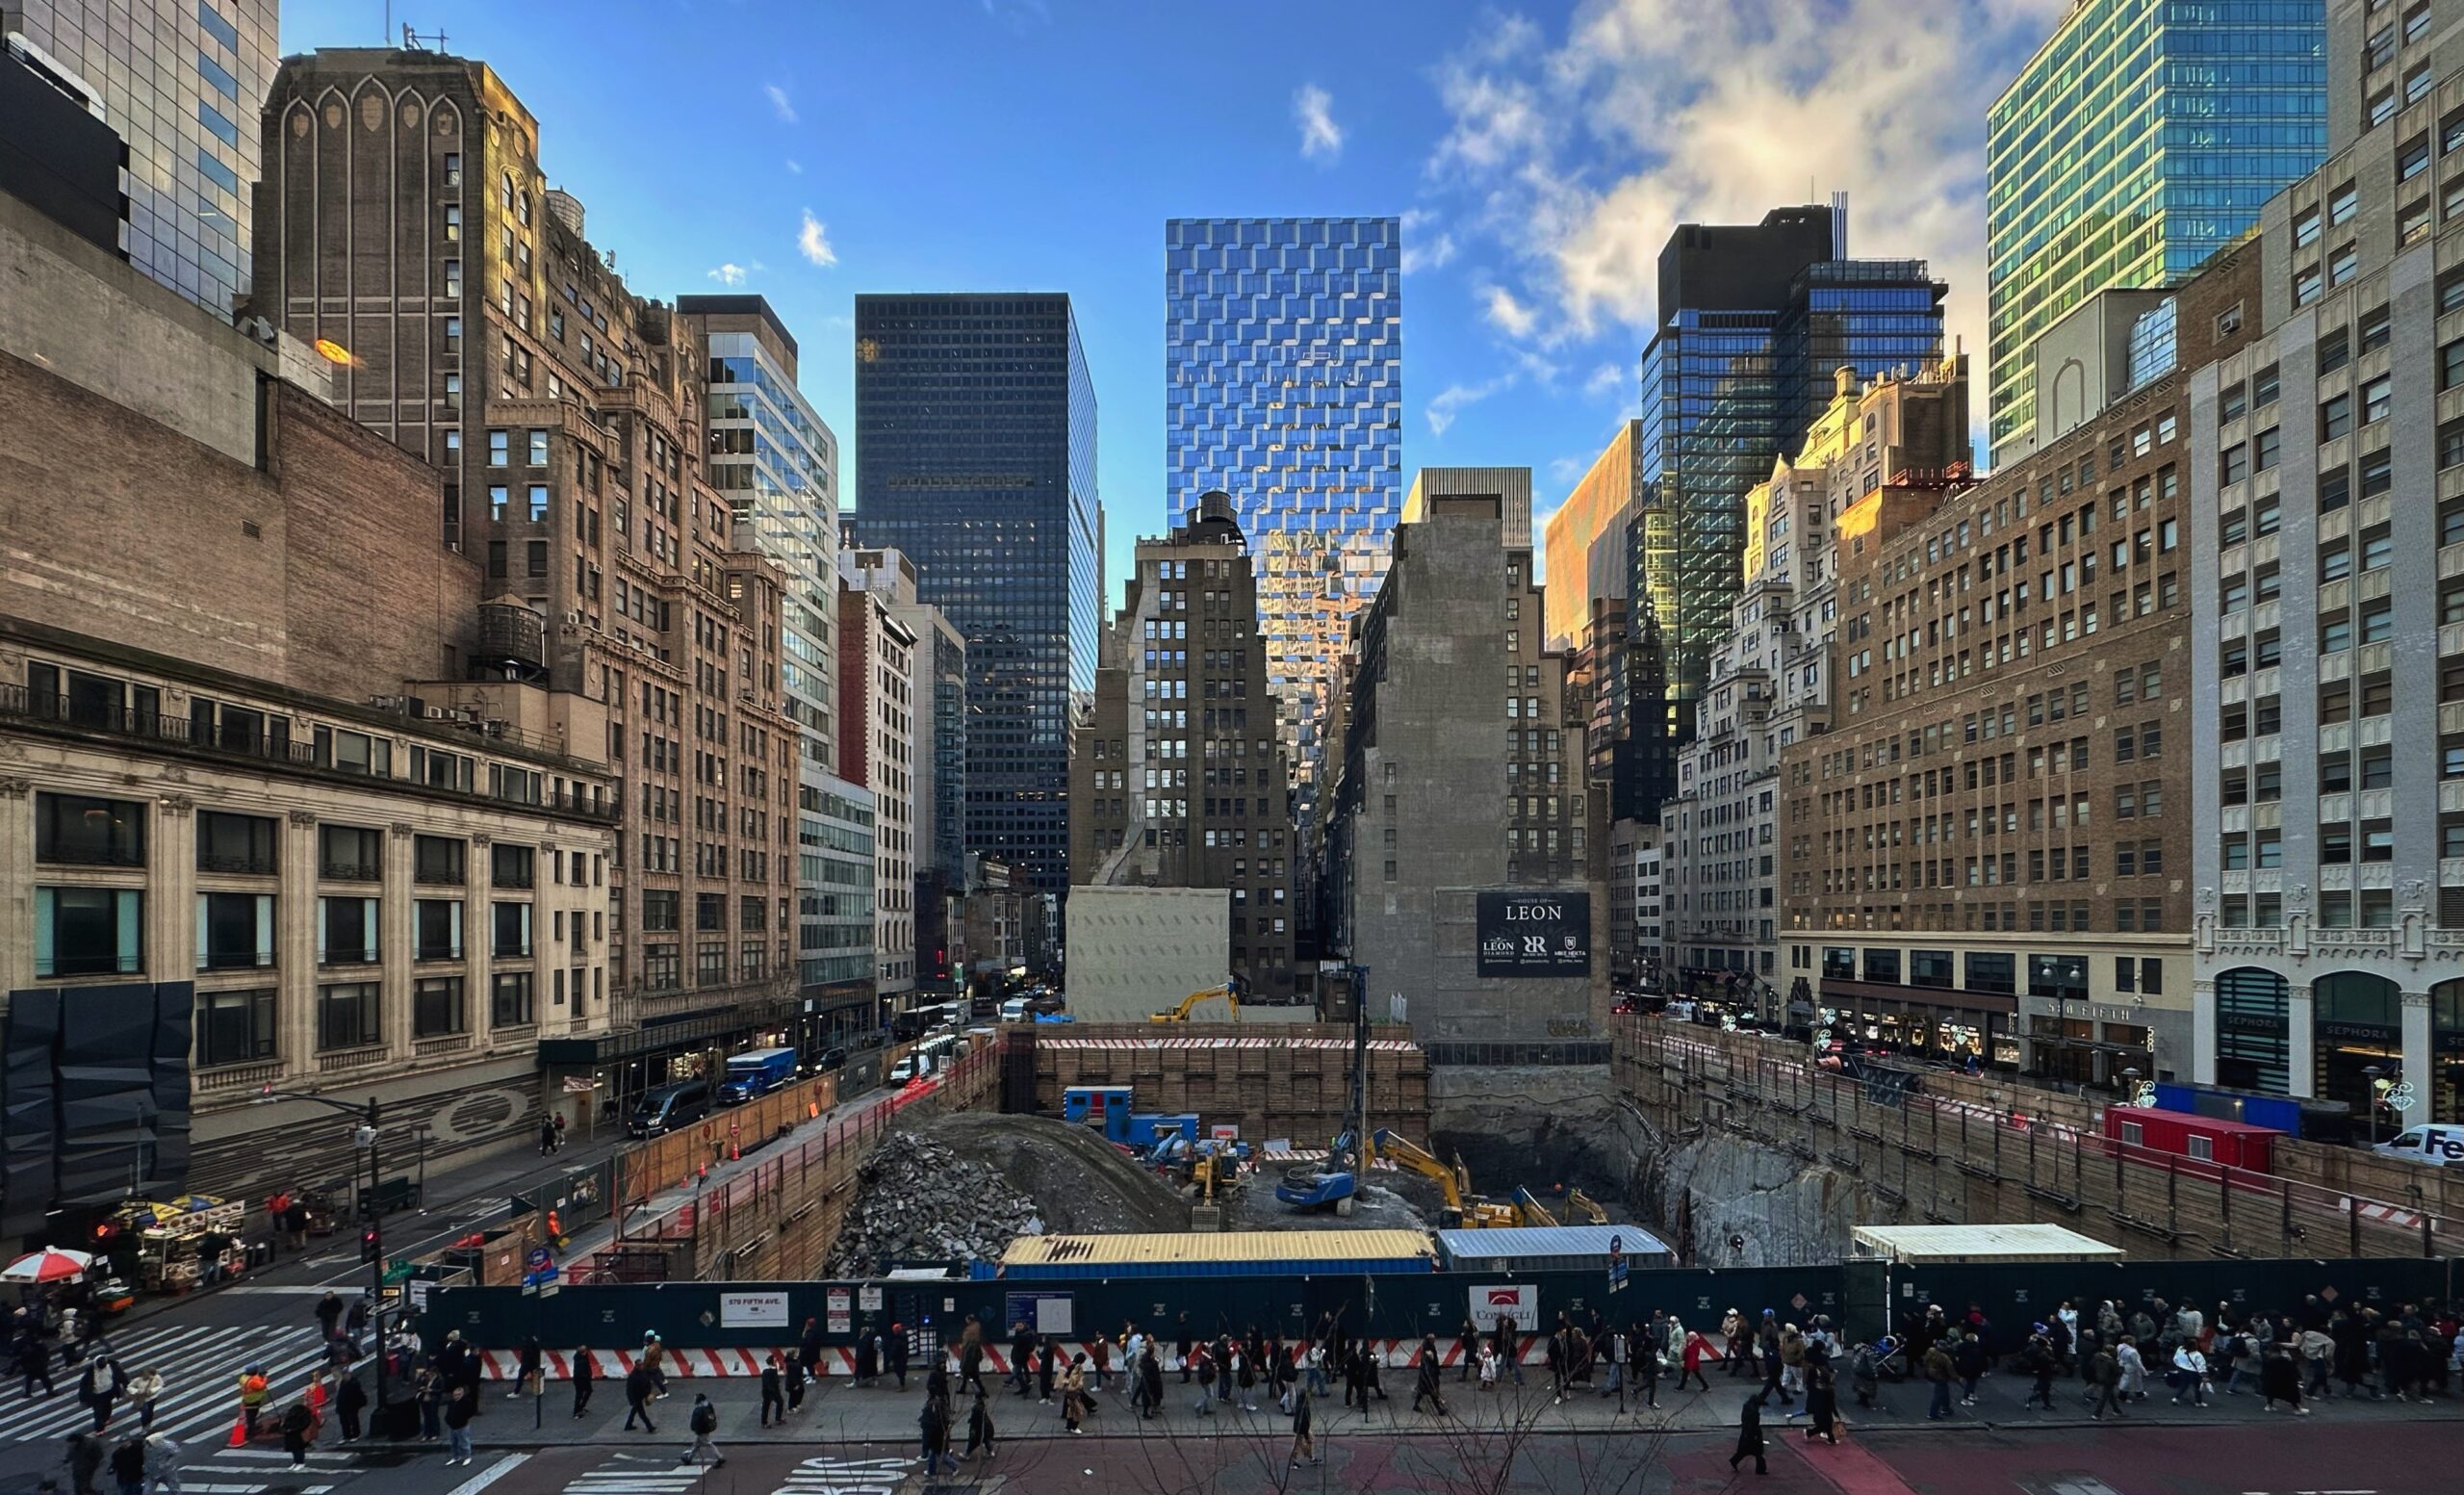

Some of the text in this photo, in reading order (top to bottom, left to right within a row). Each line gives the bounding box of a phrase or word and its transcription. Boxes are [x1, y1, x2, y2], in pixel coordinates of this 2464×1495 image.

[1505, 906, 1562, 920] LEON
[1483, 941, 1514, 951] LEON
[2082, 1005, 2129, 1020] FIFTH
[2227, 1017, 2278, 1028] SEPHORA
[2325, 1025, 2389, 1039] SEPHORA
